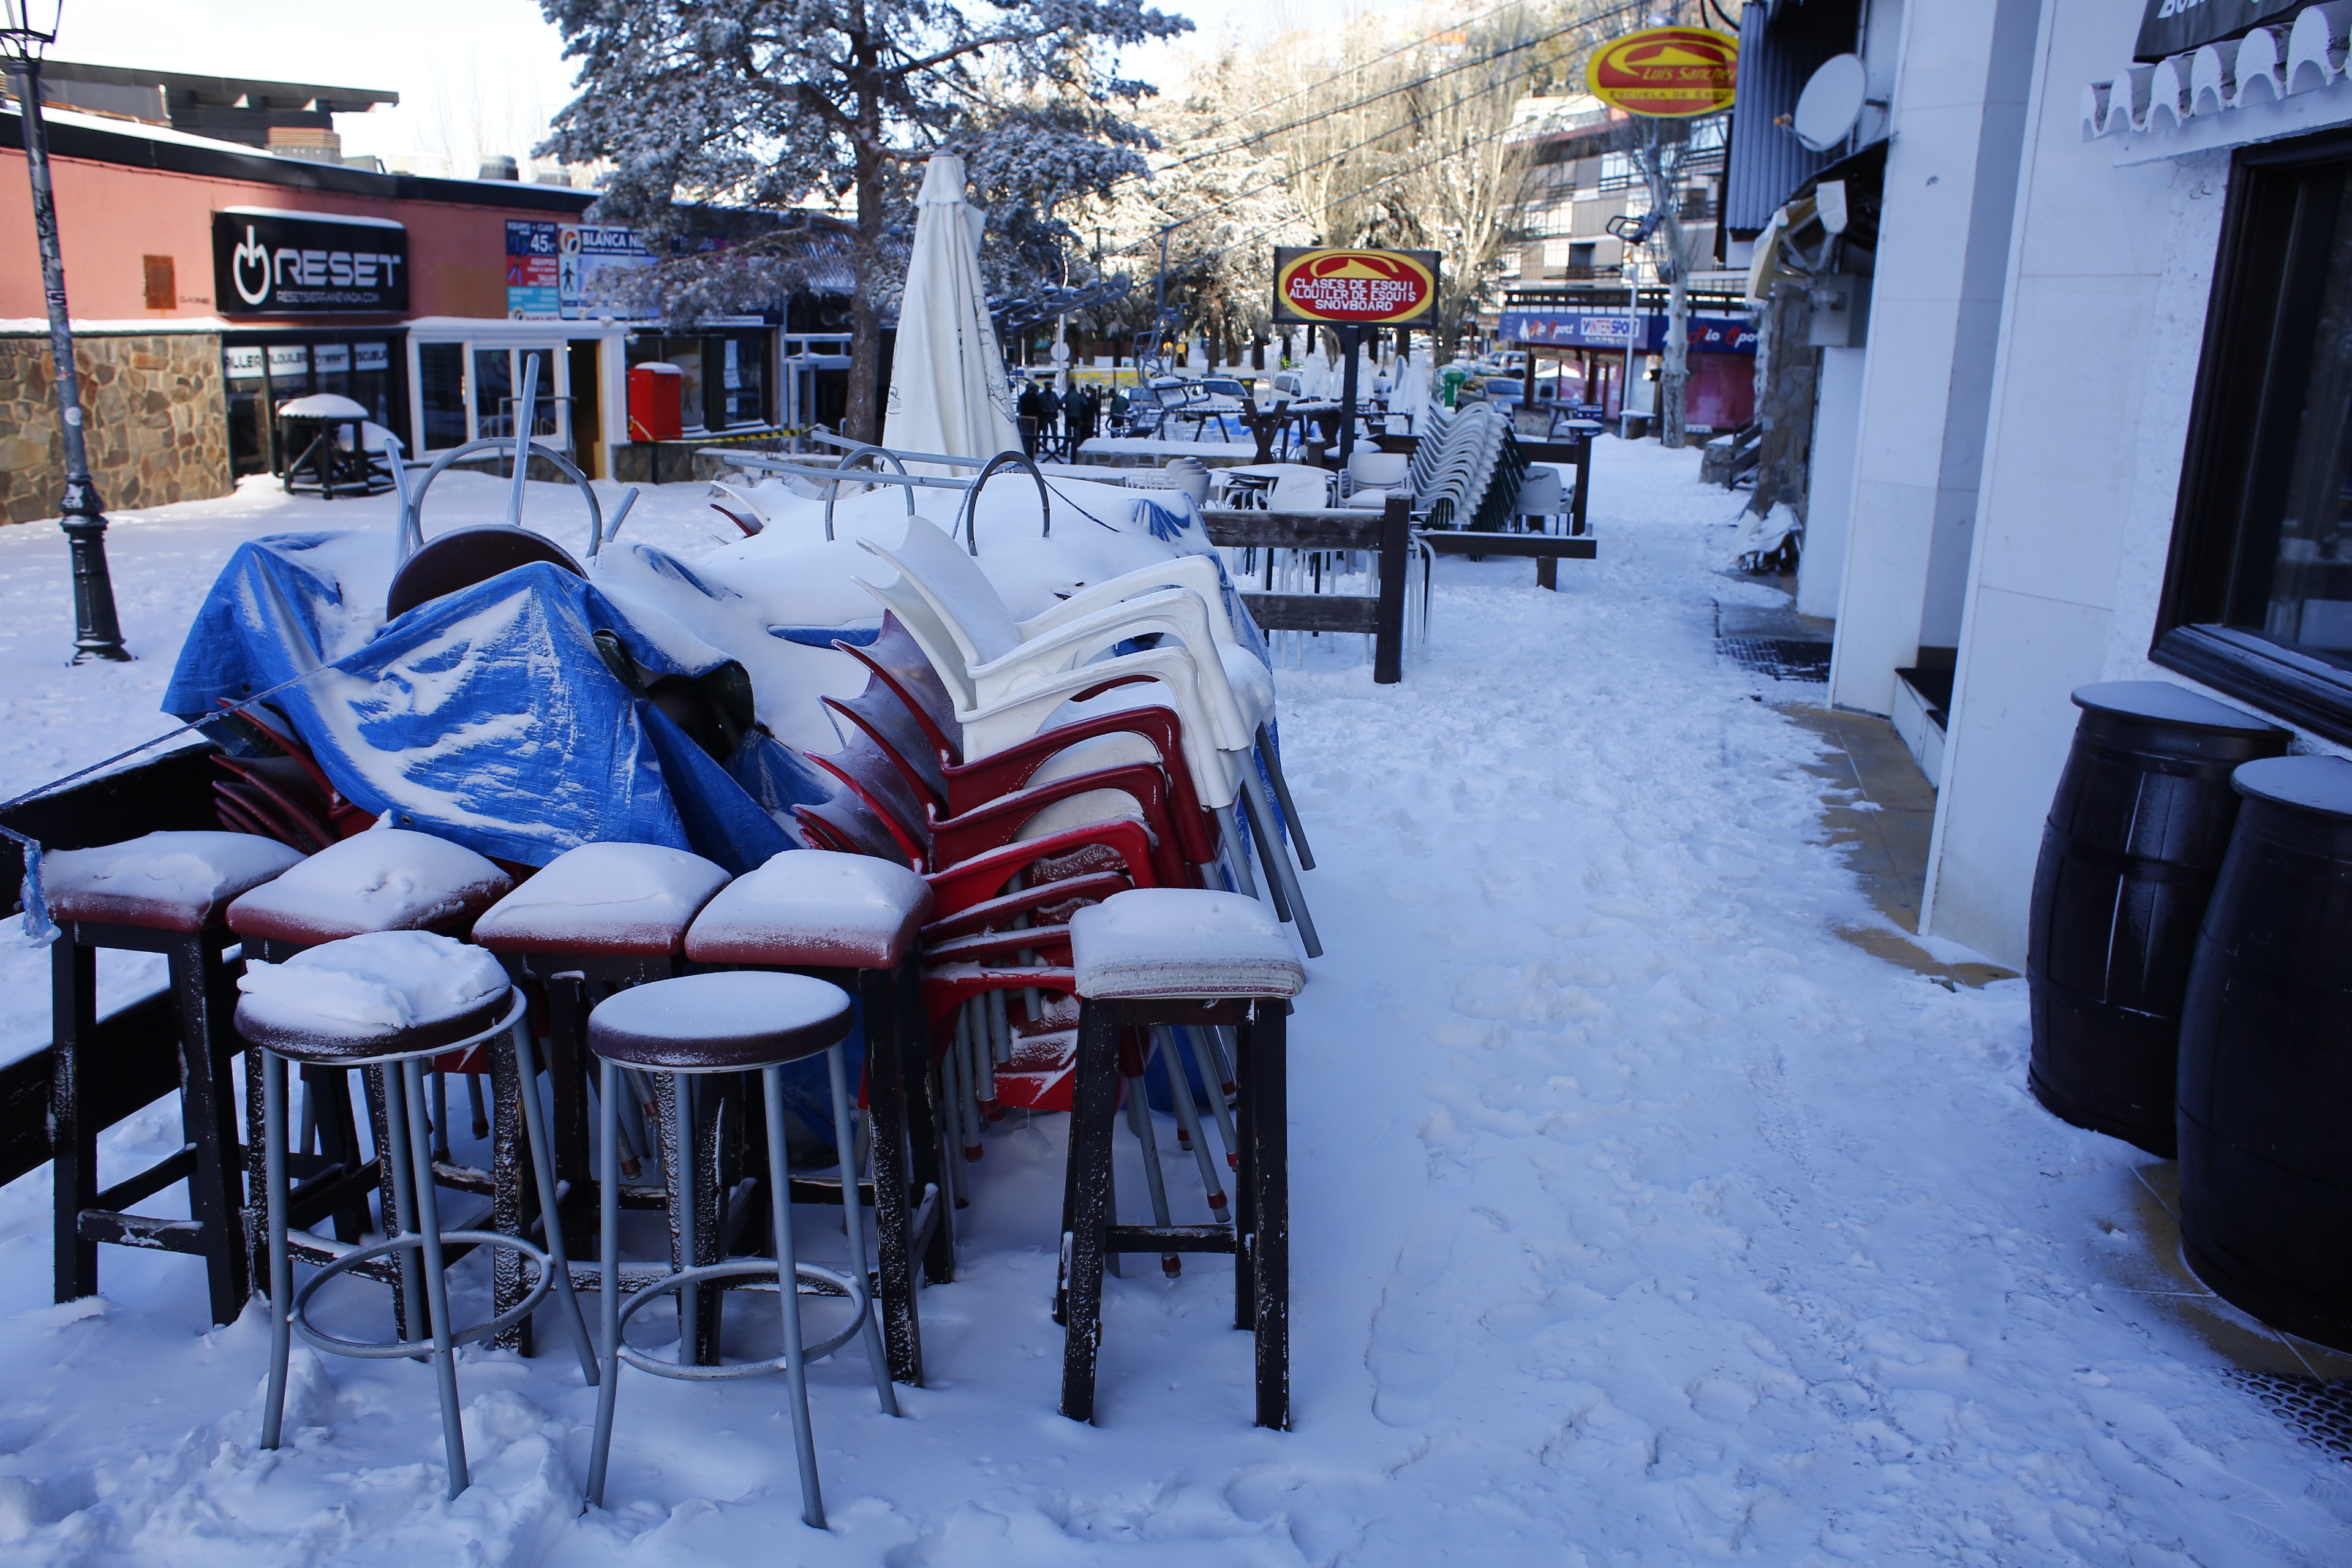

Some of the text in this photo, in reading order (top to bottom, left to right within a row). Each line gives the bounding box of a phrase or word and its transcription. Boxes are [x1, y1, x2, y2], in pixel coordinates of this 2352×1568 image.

[1642, 66, 1674, 81] Luis
[582, 232, 626, 247] BLANCA
[274, 247, 402, 287] RESET
[1293, 277, 1414, 292] CLASES DE ESQUI
[1289, 288, 1417, 302] ALQUILER DE ESQUIS
